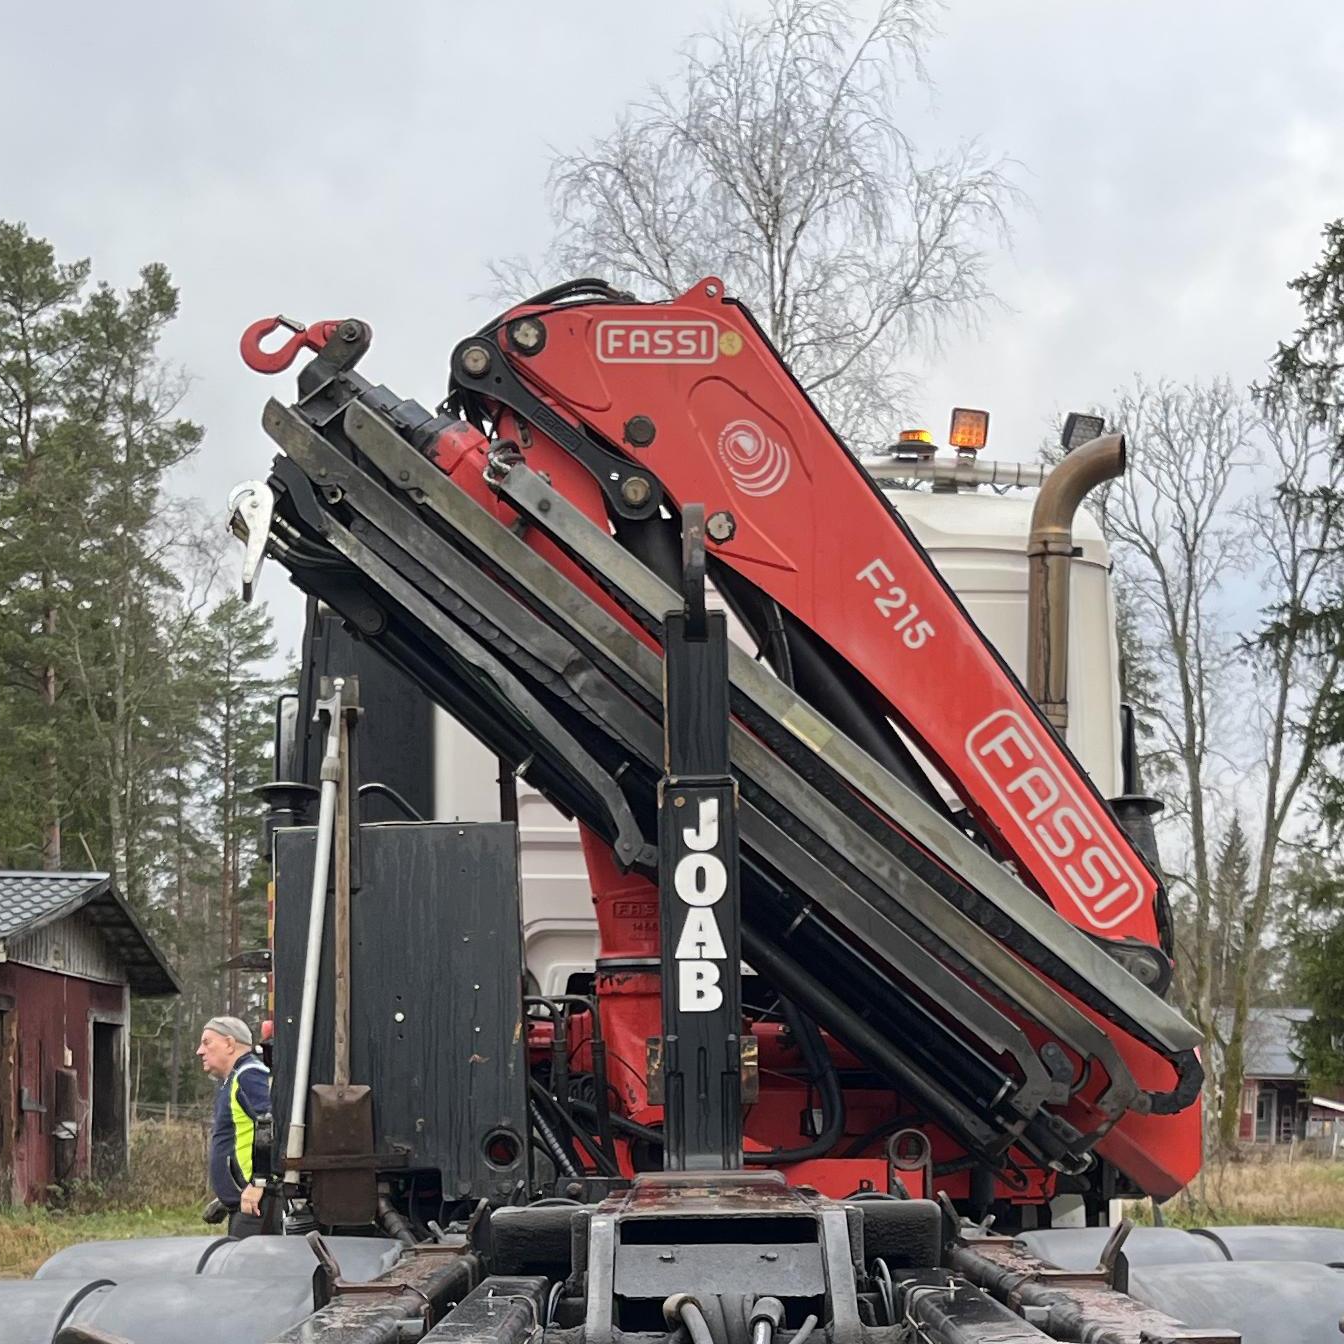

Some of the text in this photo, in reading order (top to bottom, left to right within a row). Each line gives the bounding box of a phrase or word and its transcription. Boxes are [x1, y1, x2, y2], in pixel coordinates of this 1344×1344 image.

[608, 329, 707, 355] FASSI
[855, 558, 936, 649] F215
[980, 726, 1130, 913] FASSI
[674, 797, 728, 1012] JOAB
